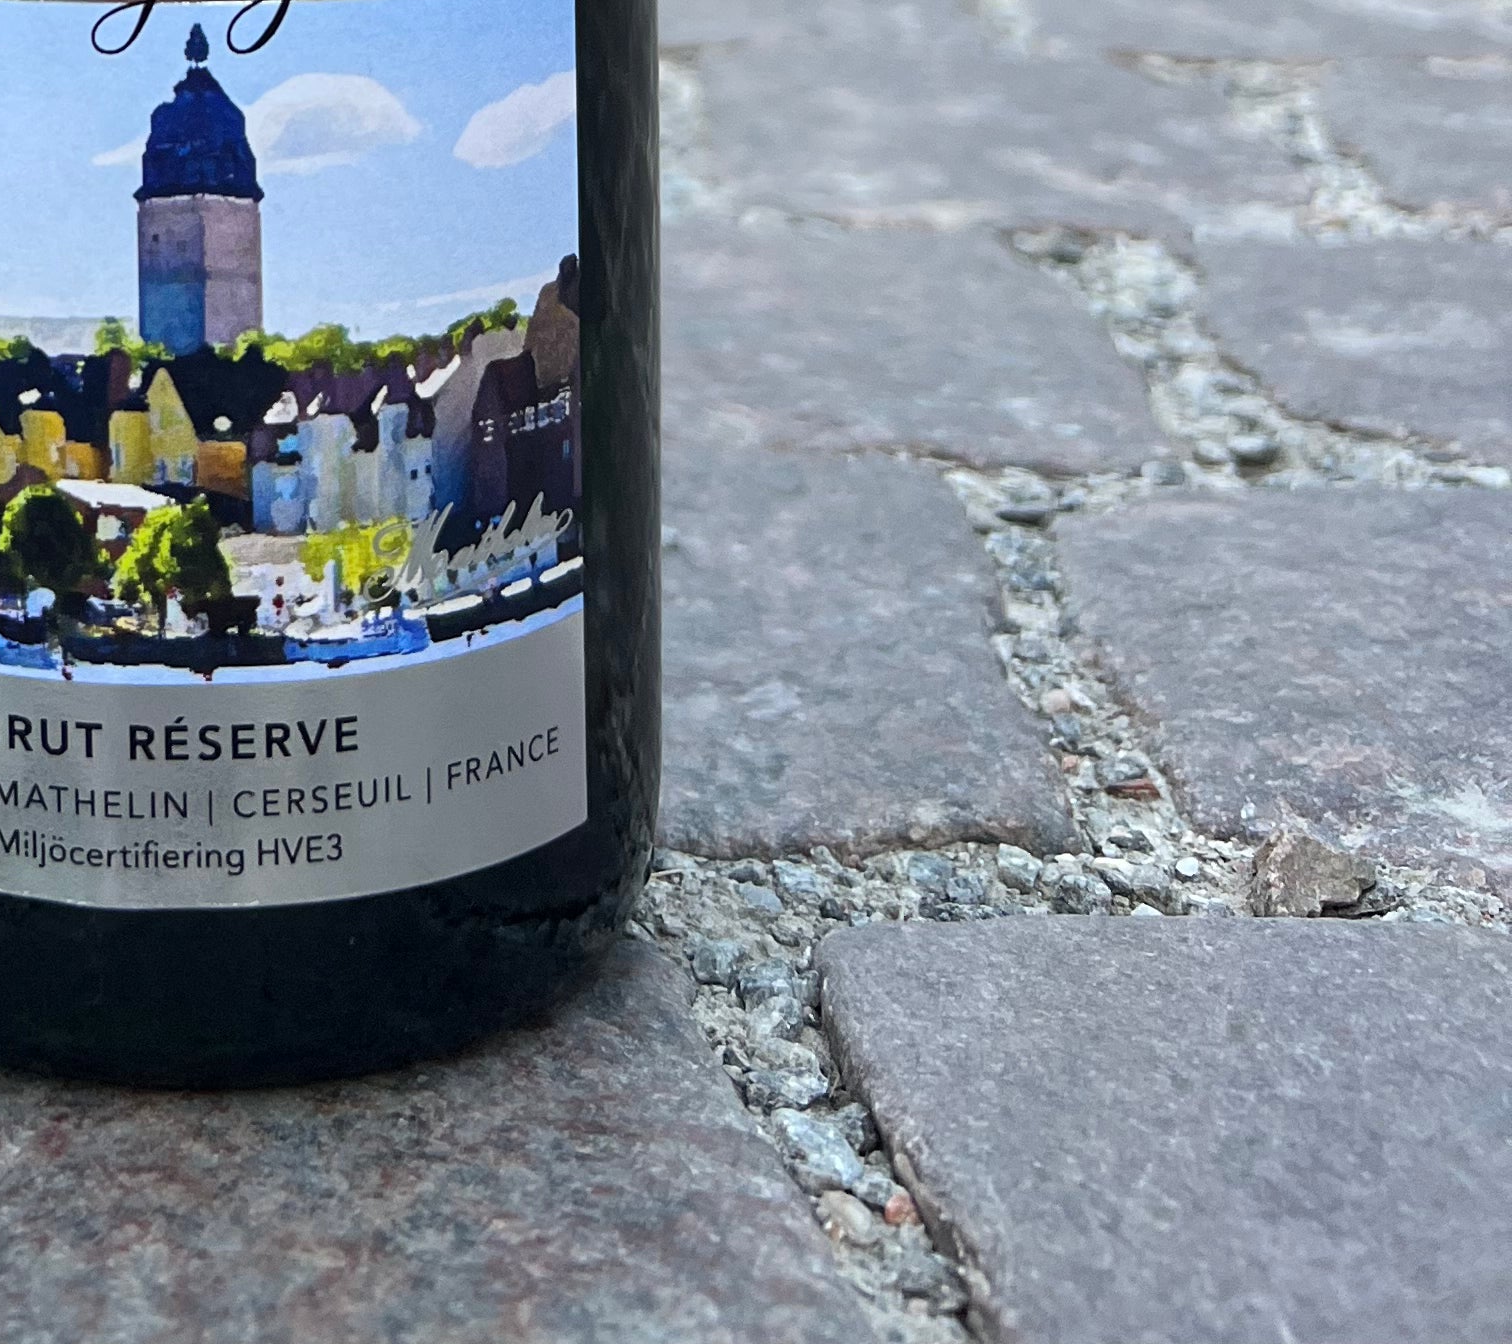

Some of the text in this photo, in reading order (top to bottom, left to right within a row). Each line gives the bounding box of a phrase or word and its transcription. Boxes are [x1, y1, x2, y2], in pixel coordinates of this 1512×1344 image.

[128, 715, 361, 761] RÉSERVE
[232, 772, 412, 820] CERSEUIL
[446, 725, 561, 791] FRANCE
[255, 833, 344, 868] HVE3
